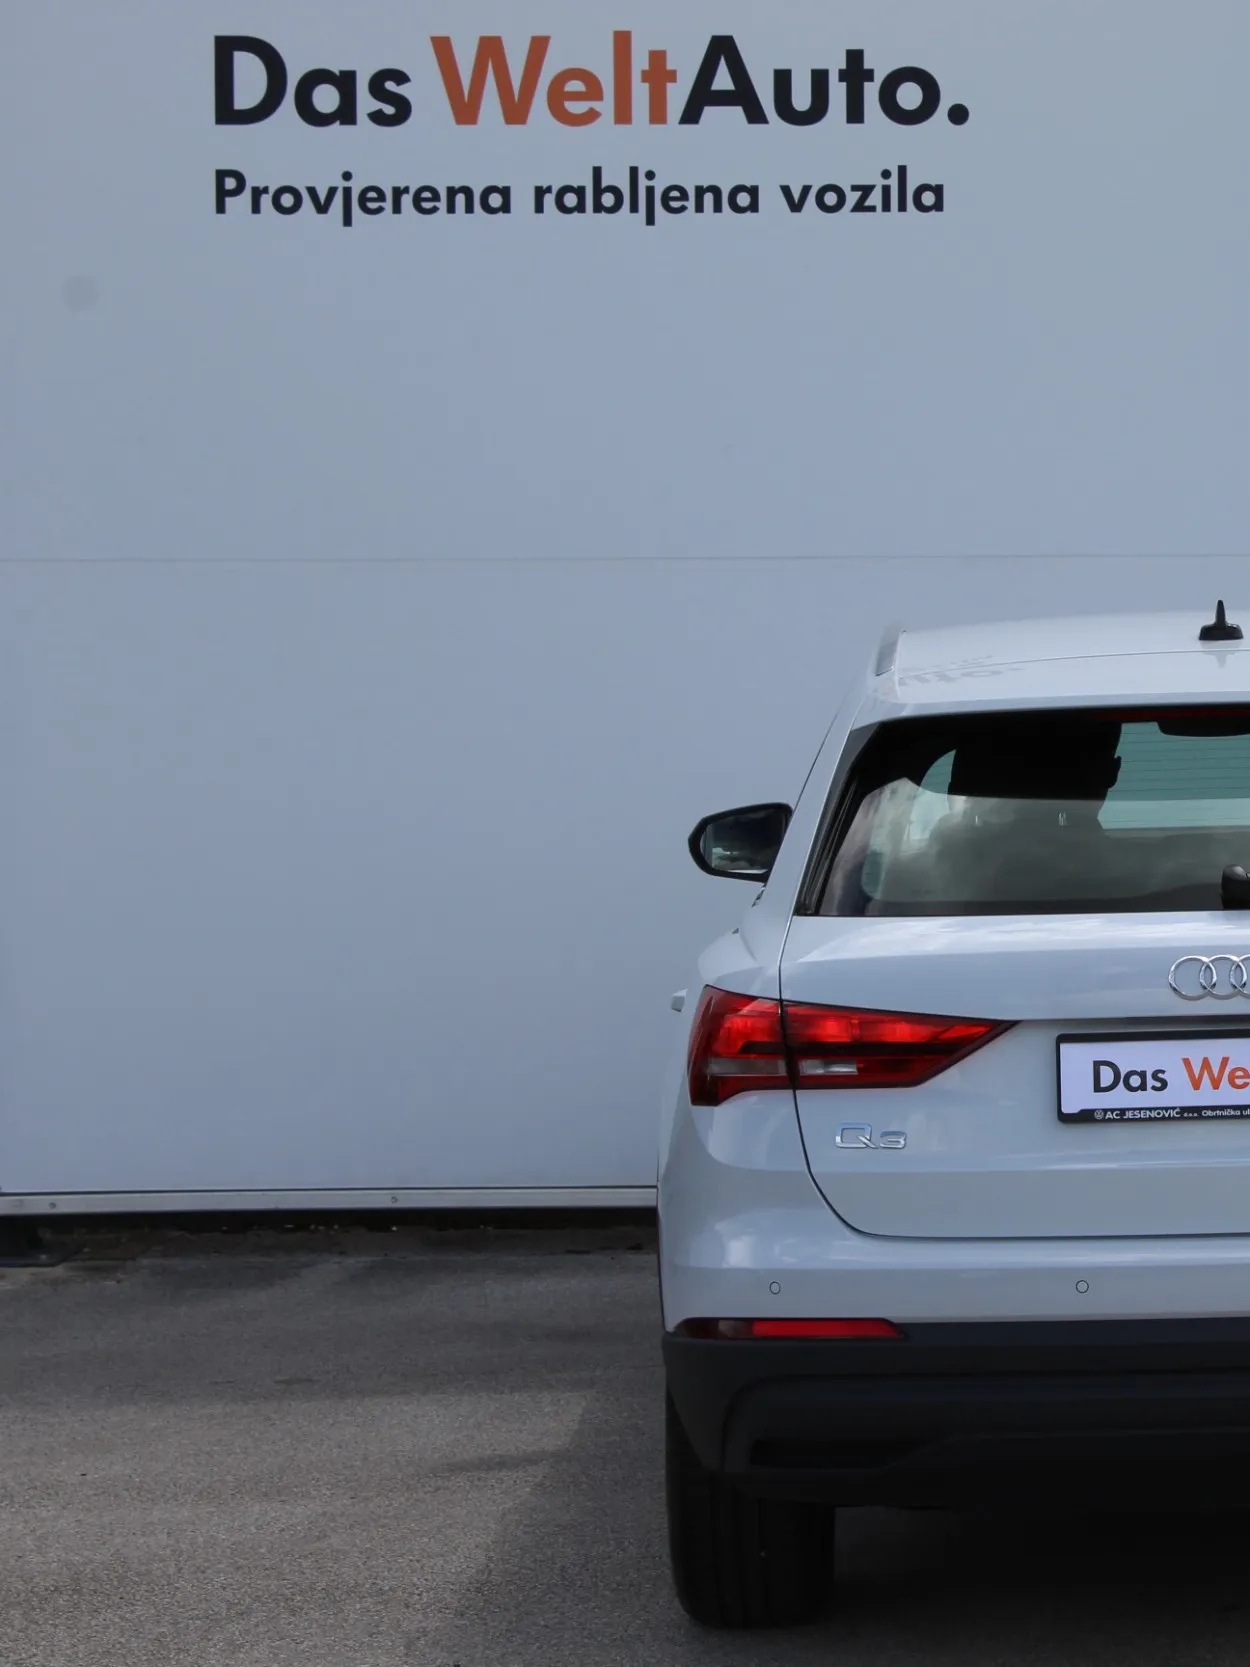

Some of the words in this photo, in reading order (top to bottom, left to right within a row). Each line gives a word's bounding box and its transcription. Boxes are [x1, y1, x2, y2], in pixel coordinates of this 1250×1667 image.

[214, 35, 412, 127] Das
[430, 30, 969, 127] WeltAuto.
[215, 169, 511, 227] Provjerena
[534, 166, 759, 226] rabljena
[779, 165, 944, 213] vozila
[1093, 1060, 1168, 1093] Das
[1105, 1110, 1121, 1120] AC
[1123, 1107, 1181, 1119] JESENOVIĆ
[1201, 1108, 1241, 1117] Obrtnička
[835, 1122, 907, 1150] Q3
